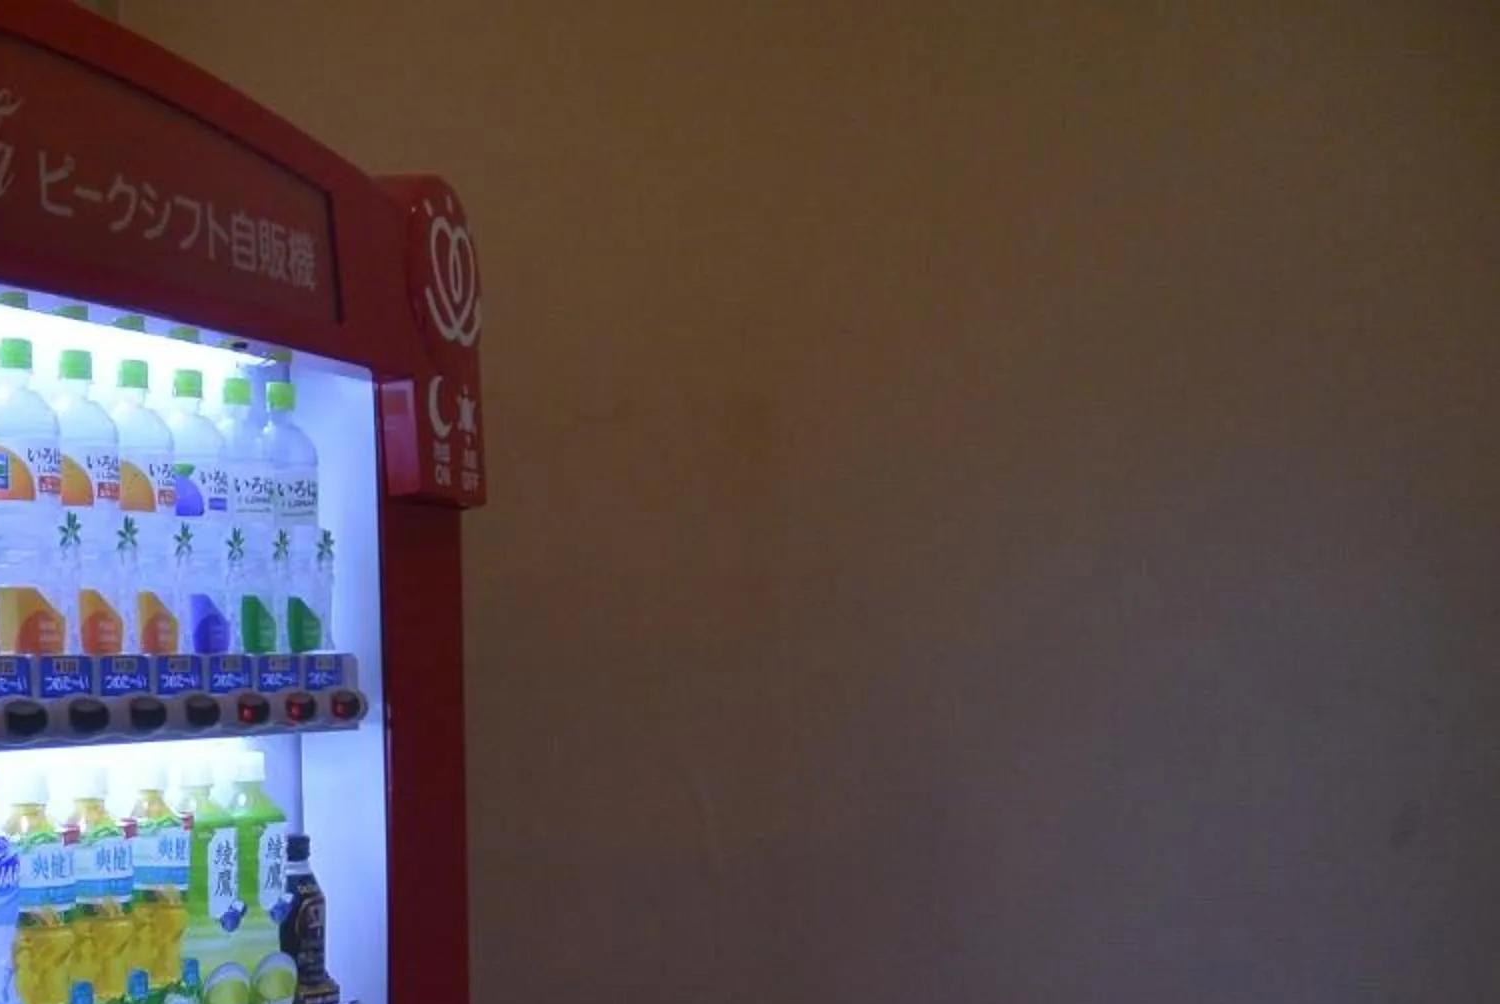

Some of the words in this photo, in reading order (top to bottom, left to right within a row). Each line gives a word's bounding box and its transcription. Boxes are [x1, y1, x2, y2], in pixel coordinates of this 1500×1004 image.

[37, 151, 319, 291] ピークシフト自販機
